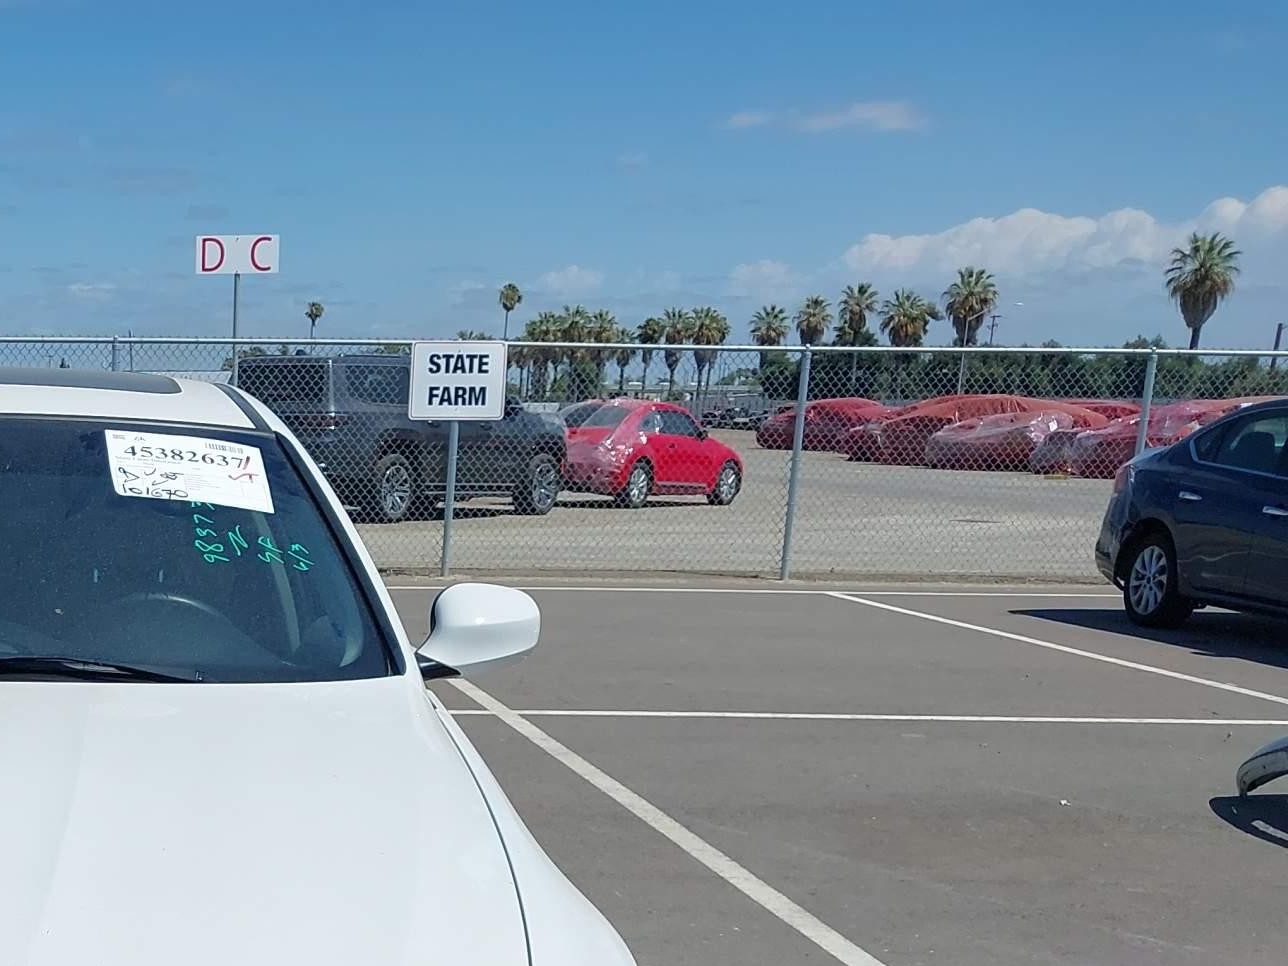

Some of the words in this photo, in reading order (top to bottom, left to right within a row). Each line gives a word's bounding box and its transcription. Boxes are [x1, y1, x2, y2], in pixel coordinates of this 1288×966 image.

[201, 237, 225, 272] D
[250, 236, 272, 271] C
[427, 353, 490, 374] STATE
[427, 386, 488, 406] FARM
[123, 445, 243, 469] 45382637
